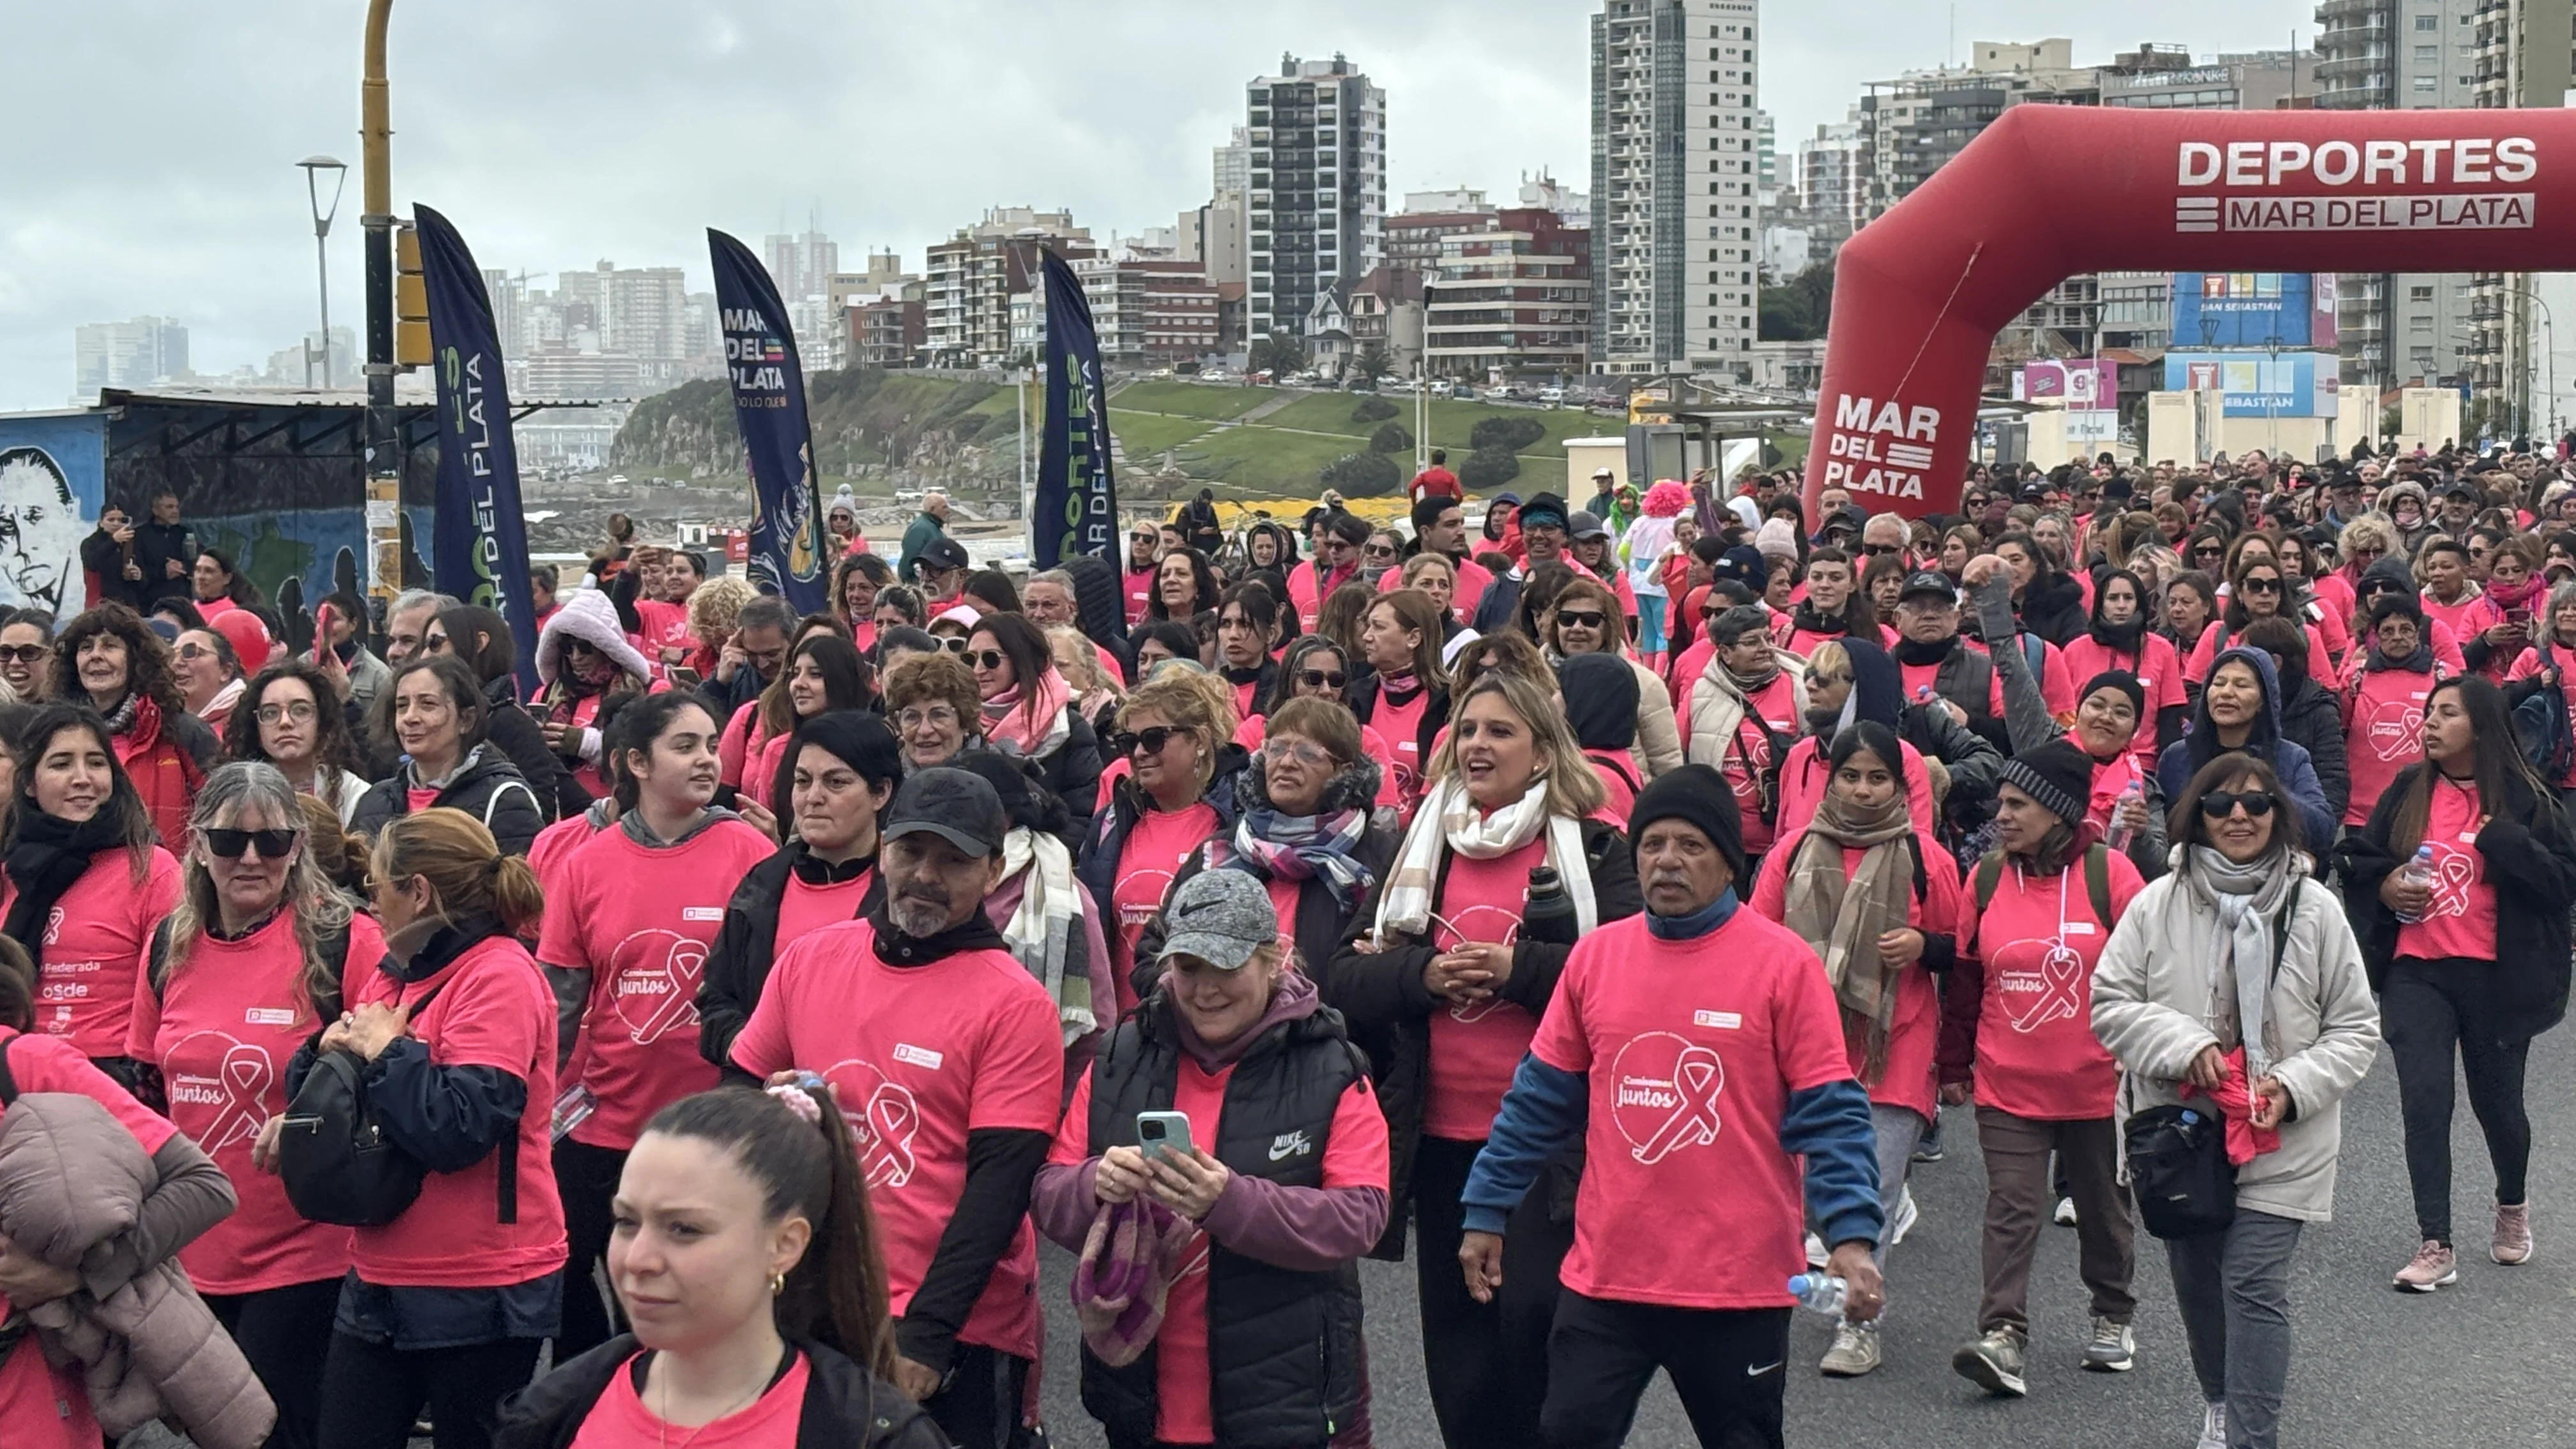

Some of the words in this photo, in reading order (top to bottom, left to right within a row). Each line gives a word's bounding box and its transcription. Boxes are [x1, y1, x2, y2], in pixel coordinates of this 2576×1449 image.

[2178, 137, 2537, 186] DEPORTES
[2230, 199, 2315, 227] MAR
[2327, 199, 2398, 227] DEL
[2409, 197, 2527, 226] PLATA
[2200, 303, 2223, 312] SAN
[725, 337, 765, 361] DEL
[466, 353, 491, 477] PLATA
[1835, 394, 1940, 443] MAR
[1830, 433, 1882, 463] DEL
[1824, 461, 1923, 500] PLATA
[477, 486, 500, 563] DEL
[45, 962, 100, 973] Federada
[617, 977, 671, 998] Juntos
[1998, 976, 2046, 993] Juntos
[171, 1080, 226, 1105] Juntos
[1616, 1084, 1678, 1108] Juntos
[1273, 1130, 1303, 1148] NIKE
